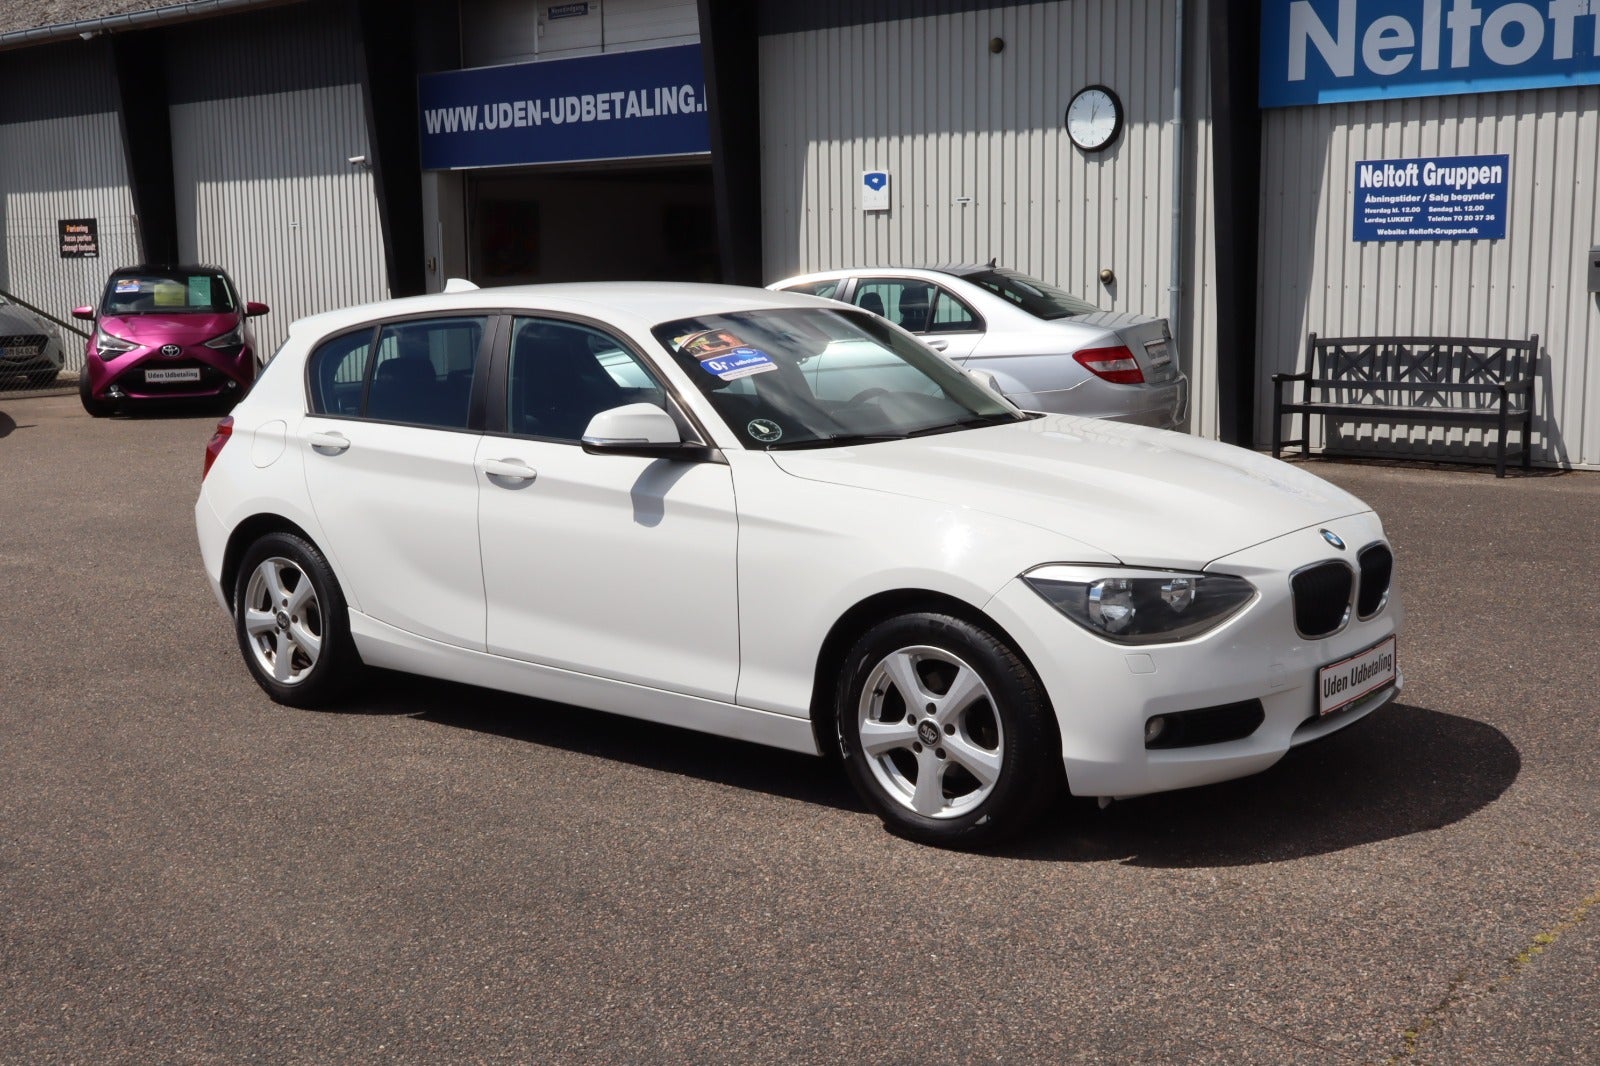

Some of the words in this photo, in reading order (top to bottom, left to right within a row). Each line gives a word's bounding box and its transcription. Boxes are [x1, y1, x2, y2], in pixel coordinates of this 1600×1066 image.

[425, 83, 708, 134] WWW.UDEN-UDBETALING.
[1360, 163, 1419, 188] Neltoft
[1423, 161, 1502, 190] Gruppen
[1365, 193, 1421, 203] Åbningstider
[1428, 193, 1449, 202] Salg
[1451, 192, 1495, 202] begynder
[1408, 227, 1478, 236] Neltoft-Gruppen.dk
[1323, 675, 1348, 698] Uden
[1350, 653, 1392, 687] Udbetaling
